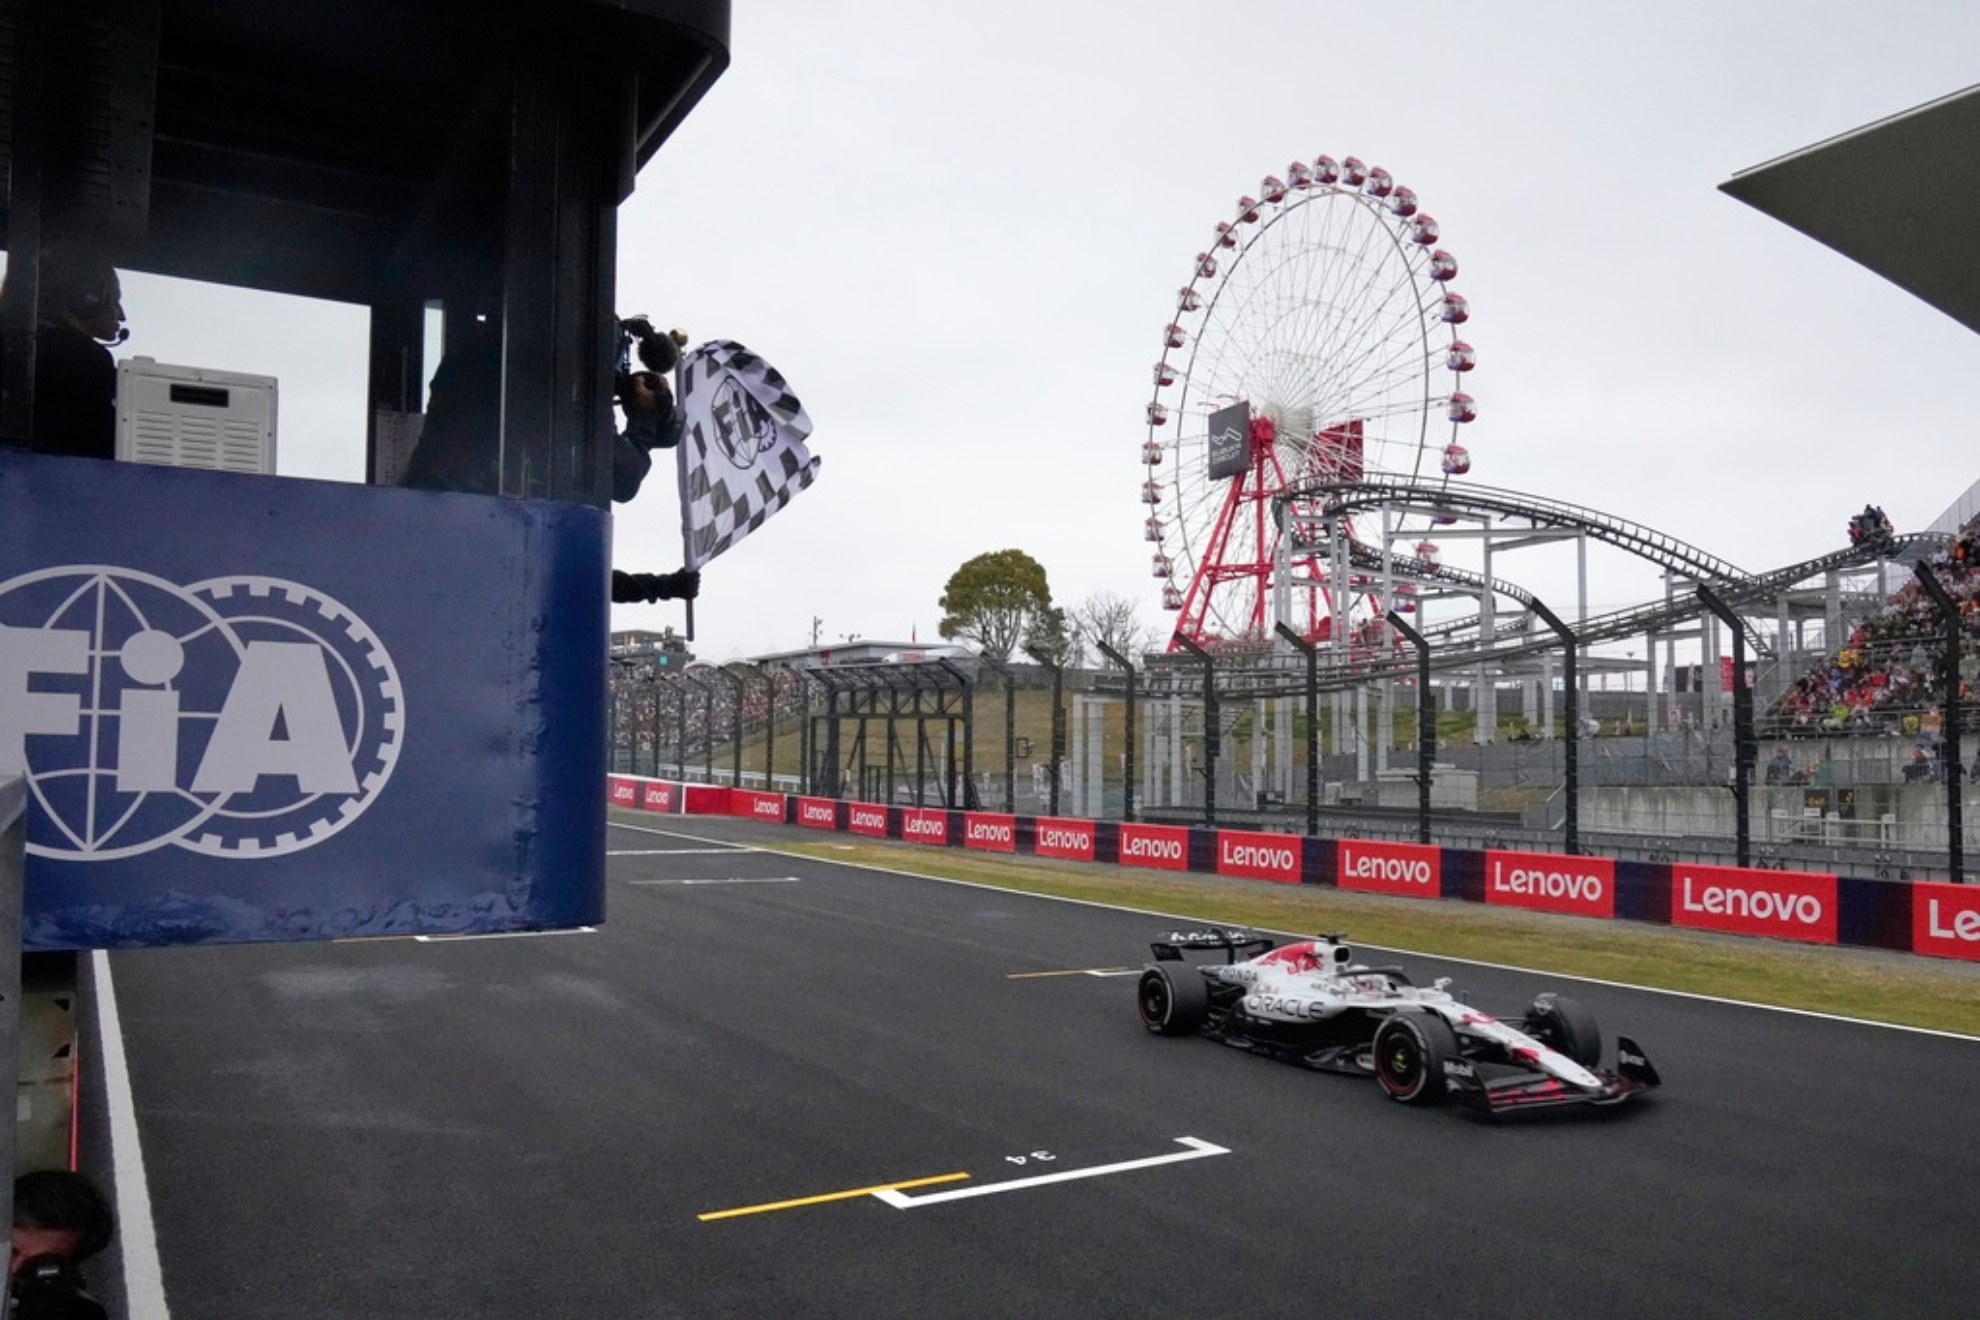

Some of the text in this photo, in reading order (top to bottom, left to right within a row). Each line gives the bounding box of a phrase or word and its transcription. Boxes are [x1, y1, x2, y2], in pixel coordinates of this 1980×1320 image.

[753, 798, 780, 815] Lenovo
[803, 802, 833, 822] Lenovo
[850, 808, 884, 829] Lenovo
[904, 817, 943, 836] Lenovo
[967, 818, 1011, 842] Lenovo
[1039, 825, 1090, 850] Lenovo
[1122, 832, 1182, 860] Lenovo
[1223, 840, 1294, 871] Lenovo
[1345, 849, 1431, 884] Lenovo
[1494, 861, 1603, 901] Lenovo
[1683, 877, 1822, 924] Lenovo
[1247, 994, 1325, 1020] ORACLE
[1443, 1060, 1474, 1077] Mobil
